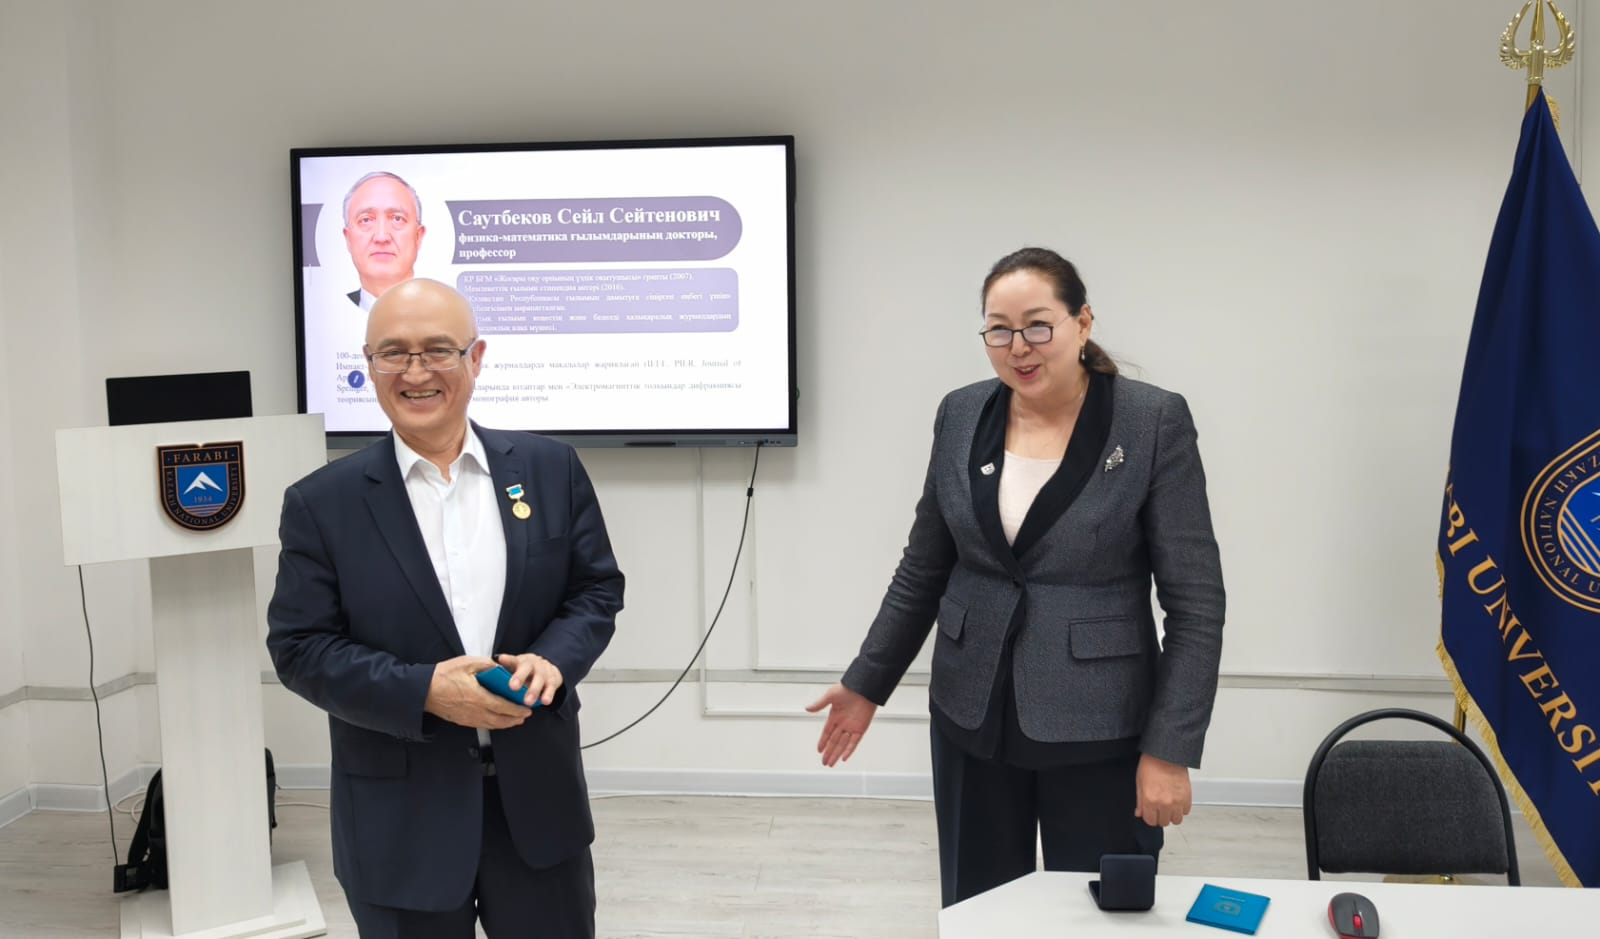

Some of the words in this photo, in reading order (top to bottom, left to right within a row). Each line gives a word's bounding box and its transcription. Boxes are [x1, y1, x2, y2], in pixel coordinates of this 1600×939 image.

[458, 209, 552, 229] Саутбеков
[557, 208, 604, 224] Сейл
[609, 207, 720, 223] Сейтенович
[458, 232, 568, 245] физика-математика
[665, 231, 718, 241] докторы,
[459, 247, 517, 260] профессор
[173, 451, 229, 463] FARABI
[1467, 555, 1600, 797] UNIVERSI
